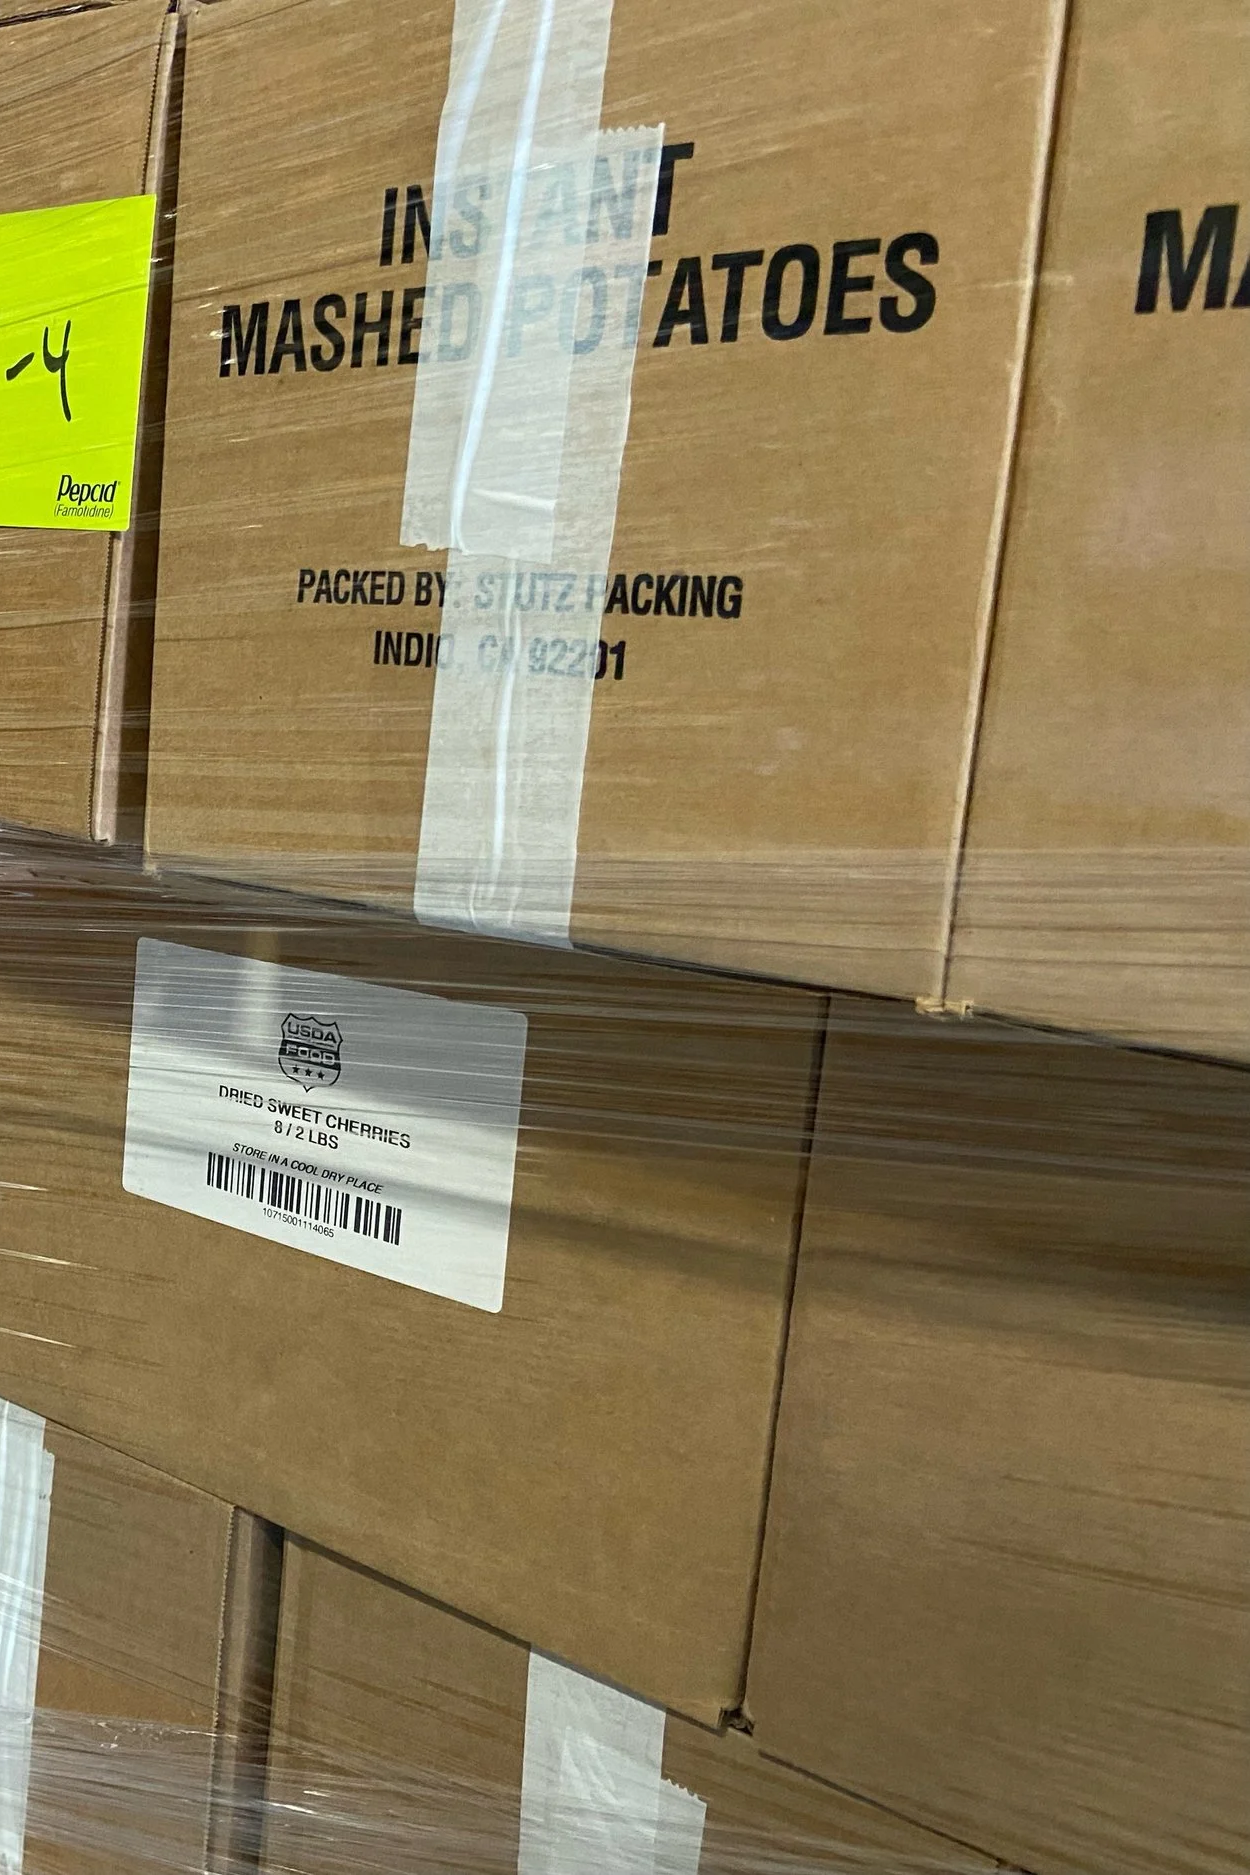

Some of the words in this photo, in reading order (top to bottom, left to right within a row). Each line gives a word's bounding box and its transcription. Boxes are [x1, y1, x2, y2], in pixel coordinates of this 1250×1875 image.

[219, 281, 480, 378] MASHED
[506, 231, 939, 358] POTATOES
[56, 474, 118, 506] Pepcid
[53, 504, 114, 519] (Famotidine)
[297, 568, 406, 606] PACKED
[474, 572, 575, 613] STUTZ
[585, 572, 744, 620] PACKING
[528, 636, 627, 681] 92201
[287, 1021, 337, 1044] USDA
[286, 1043, 335, 1066] FOOD
[218, 1085, 264, 1109] DRIED
[267, 1098, 323, 1125] SWEET
[325, 1114, 412, 1150] CHERRIES
[274, 1120, 283, 1134] 8
[295, 1126, 305, 1141] 2
[308, 1130, 339, 1150] LBS
[232, 1143, 268, 1161] STORE
[268, 1153, 281, 1165] IN
[280, 1157, 289, 1167] A
[290, 1160, 319, 1176] COOL
[321, 1169, 346, 1182] DRY
[345, 1176, 385, 1195] PLACE
[262, 1207, 335, 1238] 10715001114065
